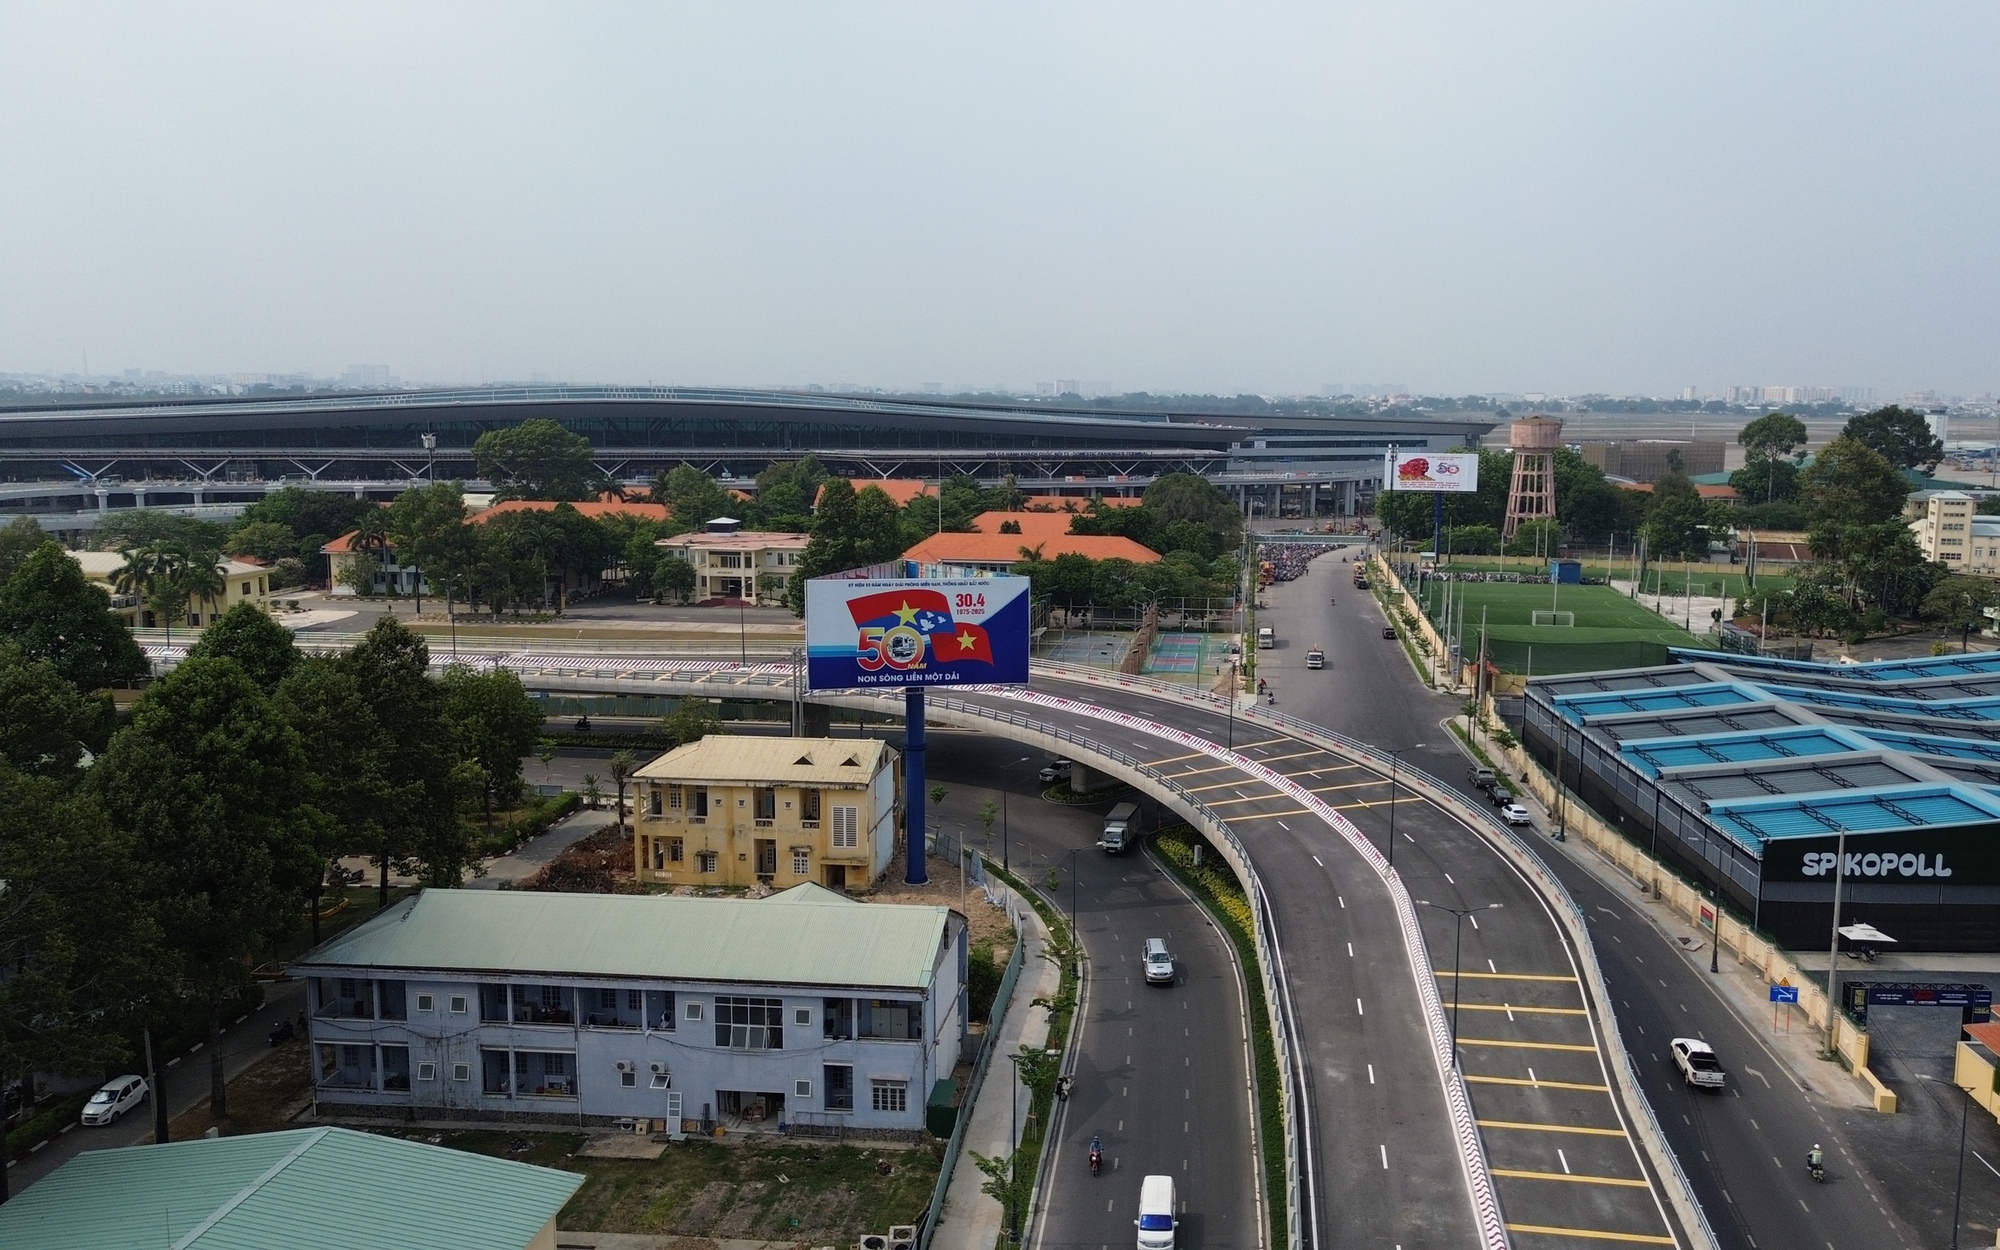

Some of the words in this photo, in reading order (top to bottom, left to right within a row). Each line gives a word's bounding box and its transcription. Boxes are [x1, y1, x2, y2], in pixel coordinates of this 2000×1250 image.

[955, 593, 985, 607] 30.4
[857, 626, 925, 671] 50
[907, 661, 927, 669] NĂM
[857, 675, 877, 683] NON
[879, 673, 904, 682] SÔNG
[925, 672, 943, 682] MỘT
[945, 671, 960, 681] DẢI
[1802, 852, 1952, 877] SPKOPOLL
